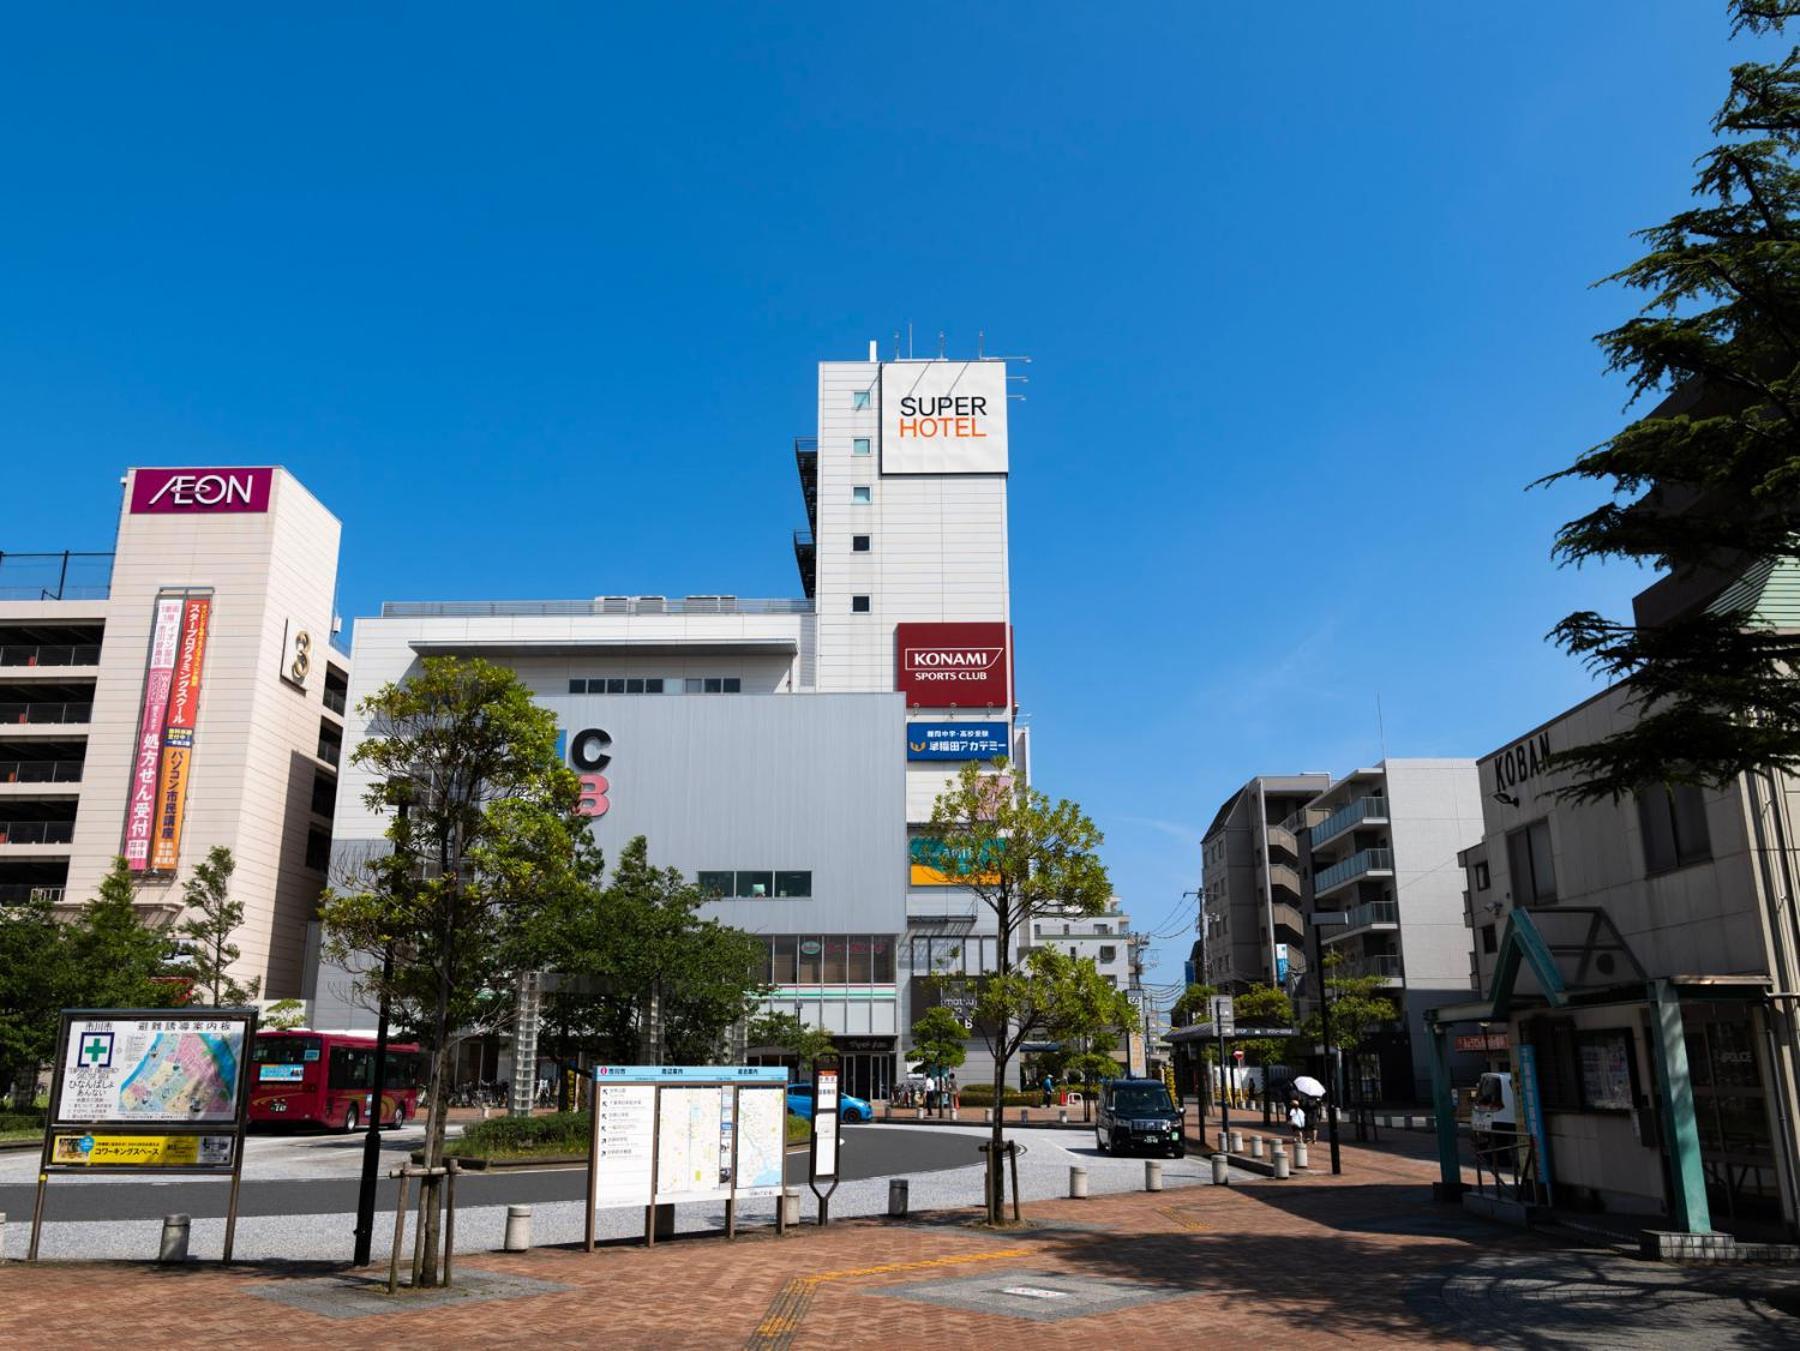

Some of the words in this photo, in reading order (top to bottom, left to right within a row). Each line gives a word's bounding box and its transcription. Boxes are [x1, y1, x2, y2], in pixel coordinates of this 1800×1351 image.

[900, 396, 987, 417] SUPER
[899, 418, 987, 438] HOTEL
[172, 604, 201, 725] スタープログラミングスクール
[914, 652, 988, 666] KONAMI
[915, 672, 957, 681] SPORTS
[958, 672, 987, 681] CLUB
[929, 741, 1007, 752] 早稲田アカデミー
[1494, 731, 1552, 792] KOBAN
[131, 733, 160, 838] 処方せん受付
[161, 750, 184, 840] パソコン市民講座
[138, 1022, 231, 1031] 避難誘導案内板
[94, 1147, 160, 1156] コワーキングスペース
